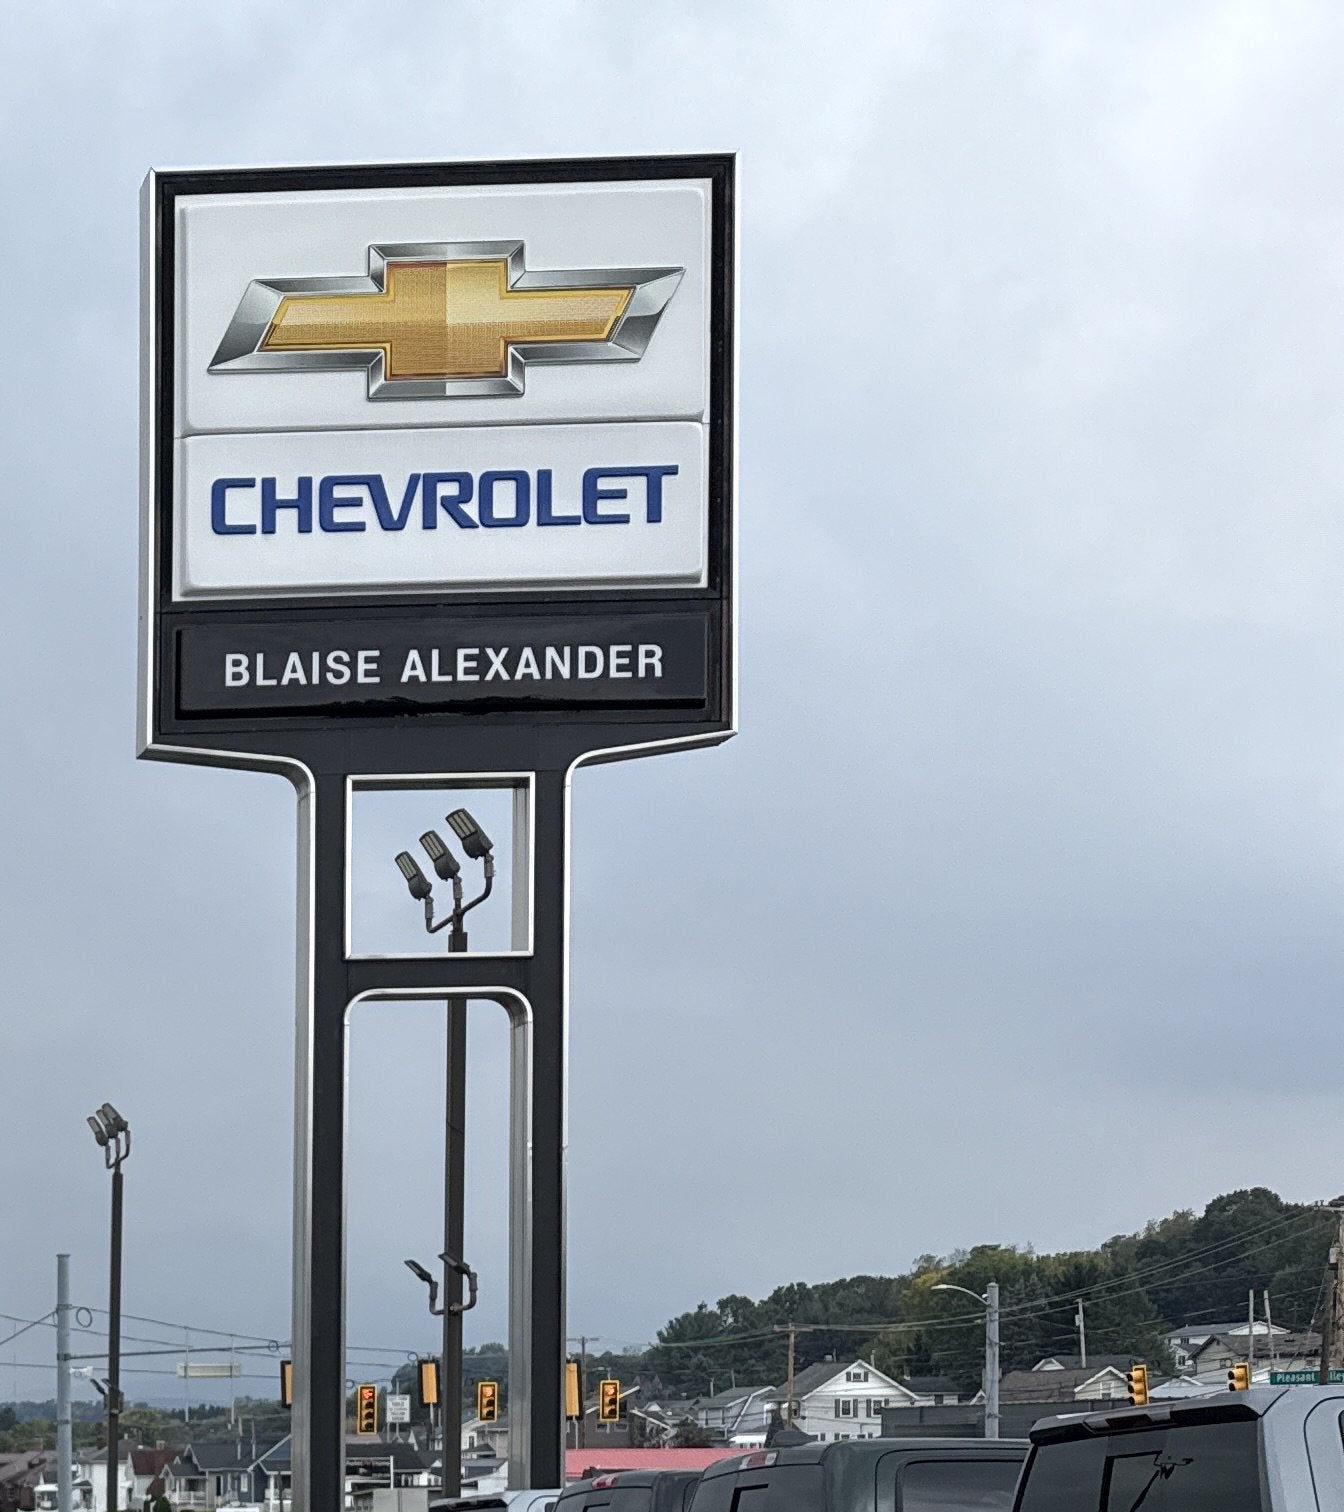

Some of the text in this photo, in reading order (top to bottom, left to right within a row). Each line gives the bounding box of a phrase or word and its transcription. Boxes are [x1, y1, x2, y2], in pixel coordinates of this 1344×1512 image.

[211, 464, 679, 536] CHEVROLET
[224, 643, 664, 688] BLAISE ALEXANDER
[1276, 1372, 1316, 1383] Pleasant
